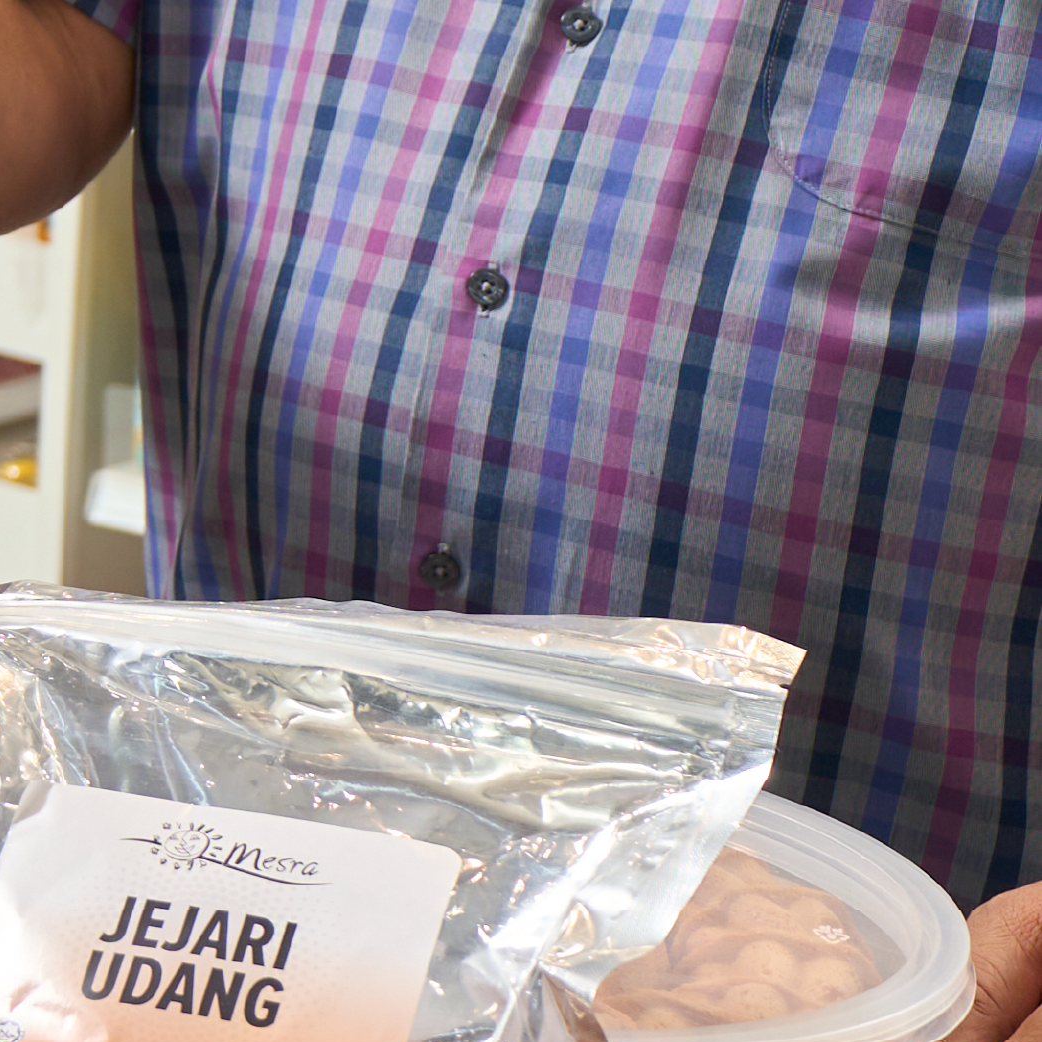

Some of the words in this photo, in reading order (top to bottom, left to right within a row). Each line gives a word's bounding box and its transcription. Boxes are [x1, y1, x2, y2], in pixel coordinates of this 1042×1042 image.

[221, 841, 320, 877] Mesra
[99, 895, 298, 971] JEJARI
[81, 950, 285, 1029] UDANG
